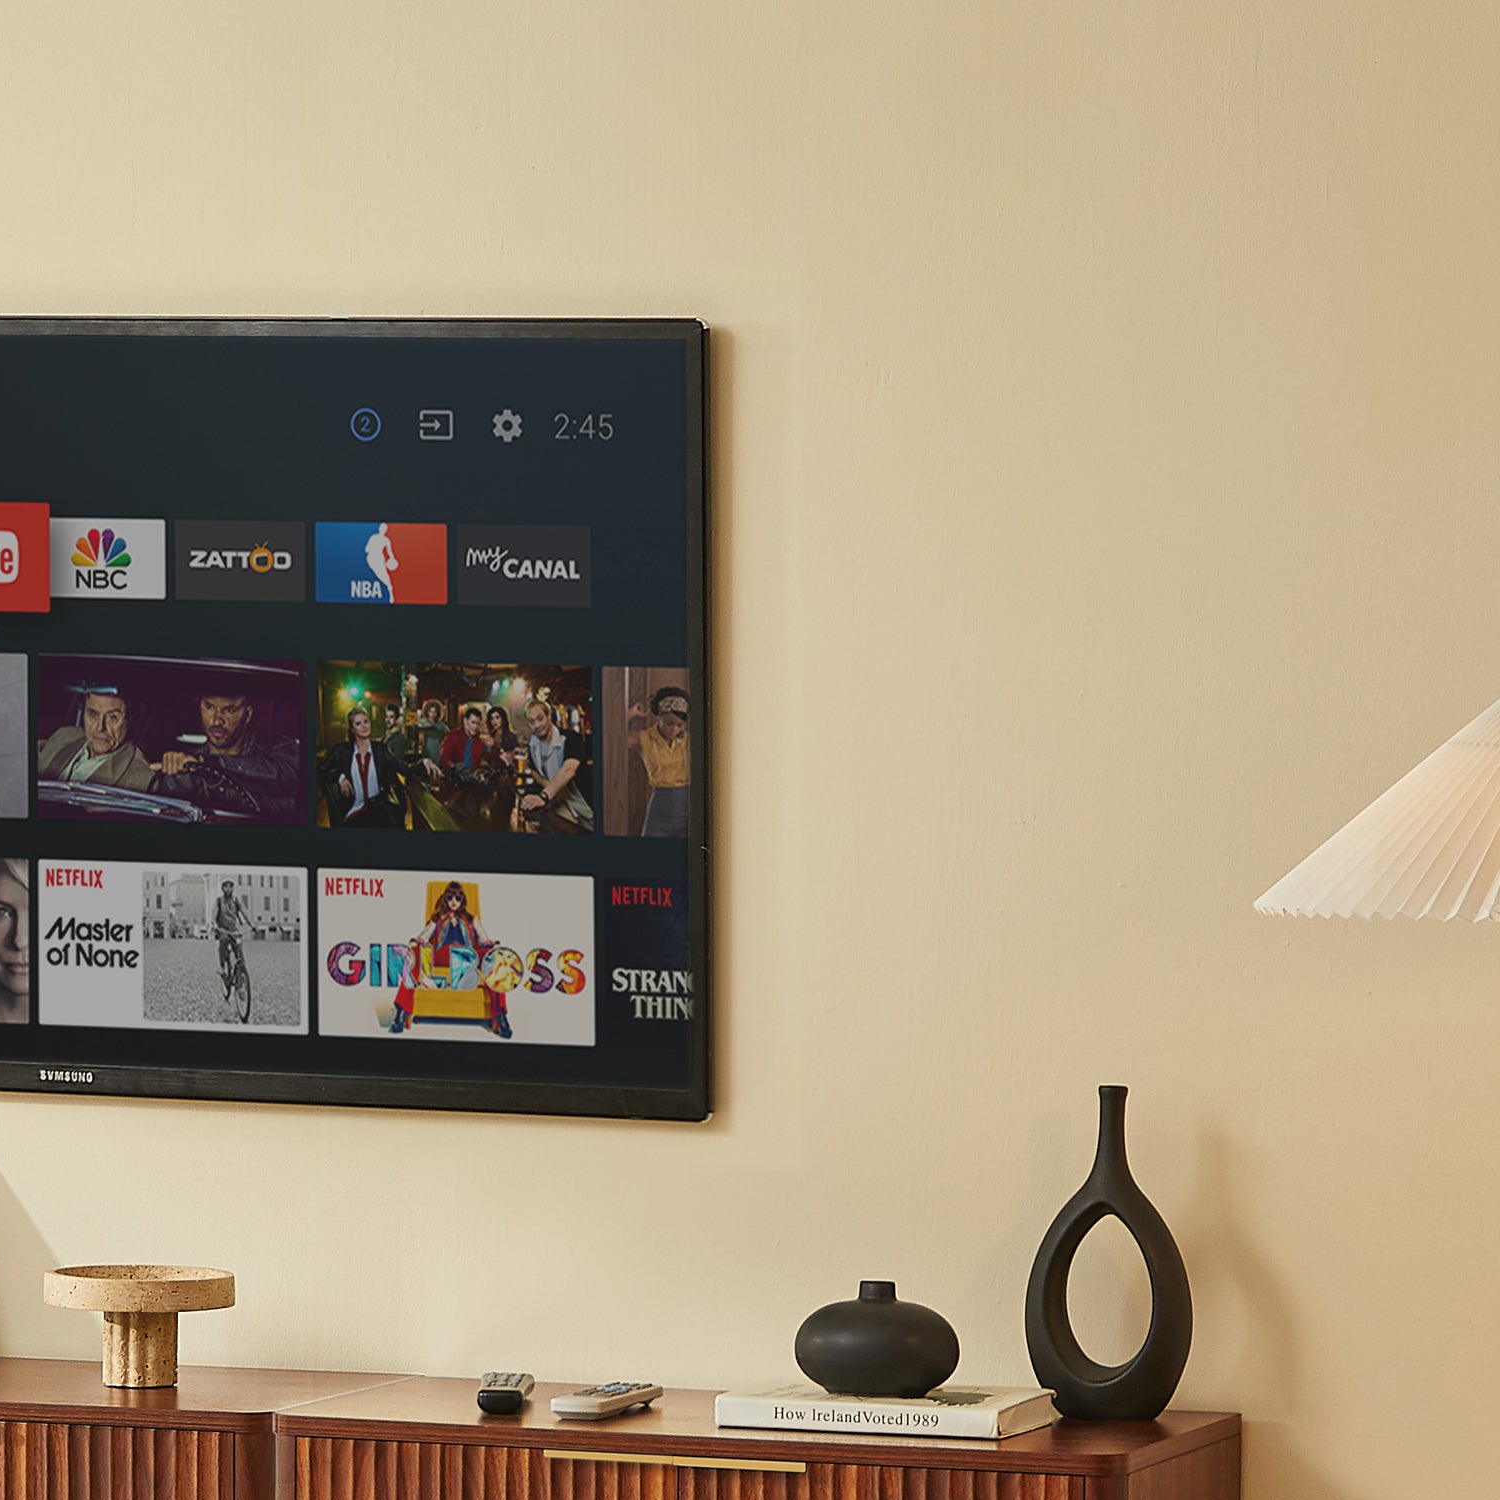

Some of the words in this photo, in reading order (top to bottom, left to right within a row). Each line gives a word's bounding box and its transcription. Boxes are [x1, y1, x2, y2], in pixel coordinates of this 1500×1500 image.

[359, 415, 371, 433] 2
[553, 412, 614, 440] 2:45
[188, 546, 293, 574] ZATTOO
[75, 569, 128, 590] NBC
[350, 580, 383, 599] NBA
[45, 868, 103, 889] NETFLIX
[324, 877, 385, 898] NETFLIX
[611, 886, 673, 908] NETFLIX
[44, 916, 134, 943] Master
[46, 942, 70, 966] of
[75, 942, 140, 968] None
[612, 967, 693, 994] STRAN
[630, 995, 693, 1020] THIN
[773, 1406, 806, 1421] How
